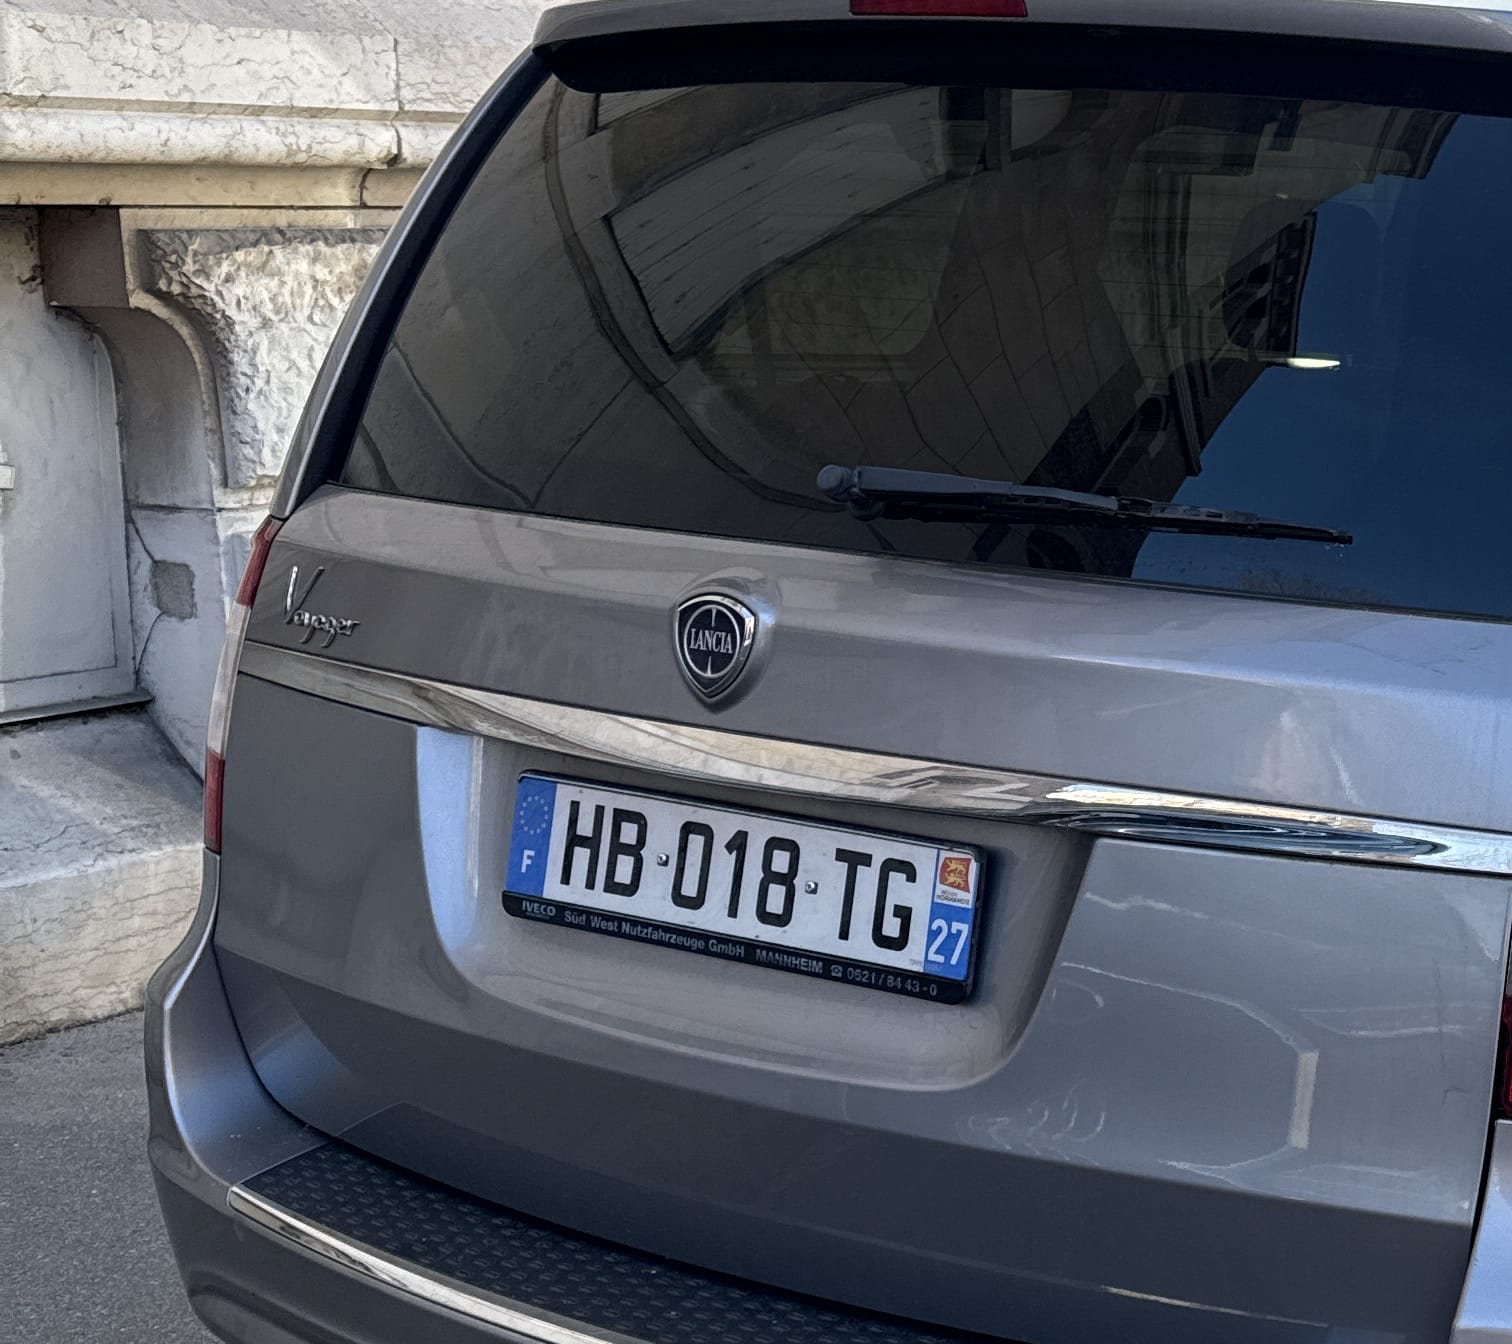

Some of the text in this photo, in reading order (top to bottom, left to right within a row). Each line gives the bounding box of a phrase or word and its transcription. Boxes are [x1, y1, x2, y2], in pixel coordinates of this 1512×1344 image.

[284, 565, 361, 648] Voyager
[689, 628, 733, 654] LANCIA
[521, 849, 535, 873] F
[522, 900, 556, 917] IVECO
[564, 910, 587, 926] Süd
[589, 914, 619, 932] West
[621, 923, 706, 951] Nutzfahrzeuge
[708, 938, 745, 958] GmbH
[756, 948, 824, 974] MANNHEIM
[927, 918, 969, 966] 27
